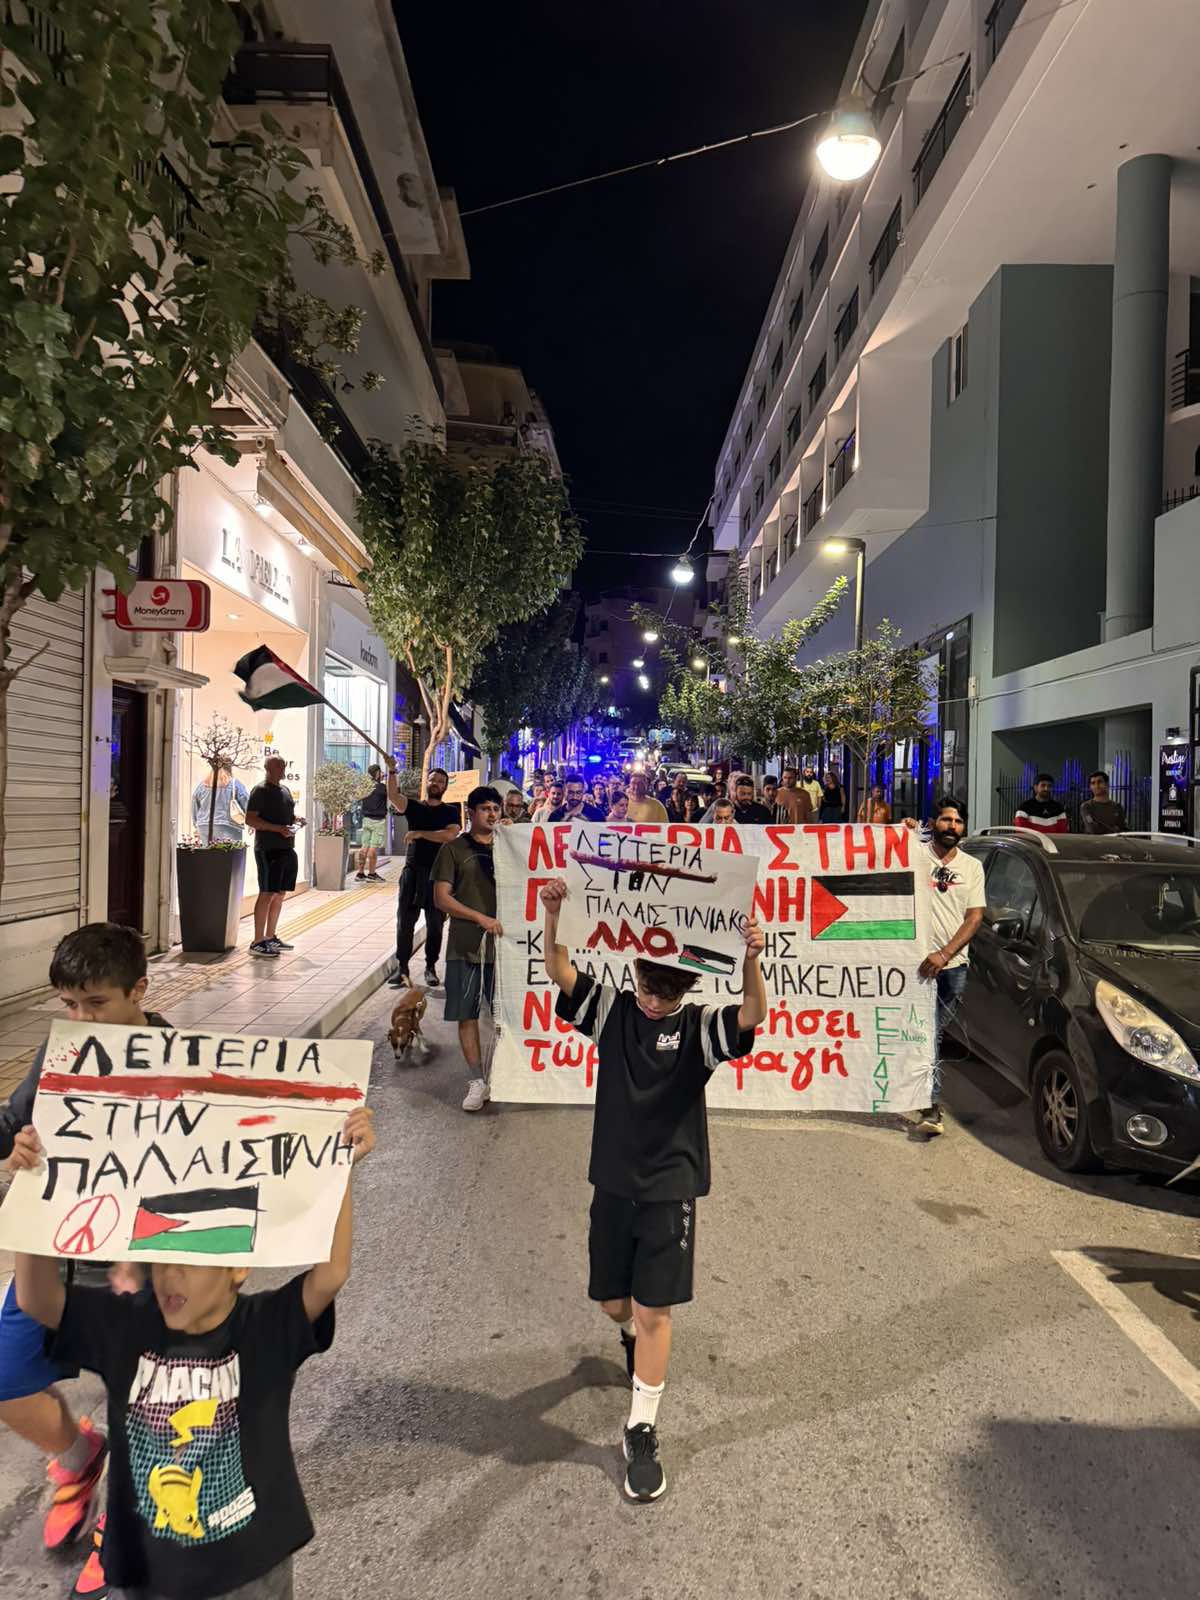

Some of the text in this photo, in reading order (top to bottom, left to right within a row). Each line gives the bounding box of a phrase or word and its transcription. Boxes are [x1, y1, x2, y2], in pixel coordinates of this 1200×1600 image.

[134, 607, 185, 616] MoneyGram
[576, 829, 703, 872] ΛΕΥΤΕΡΙΑ
[765, 825, 909, 871] ΣΤΗΝ
[586, 918, 678, 957] ΛΑΟ
[760, 961, 905, 998] ΜΑΚΕΛΕΙΟ
[70, 1030, 321, 1076] ΛΕΥΤΕΡΙΑ
[54, 1097, 209, 1140] ΣΤΗΝ
